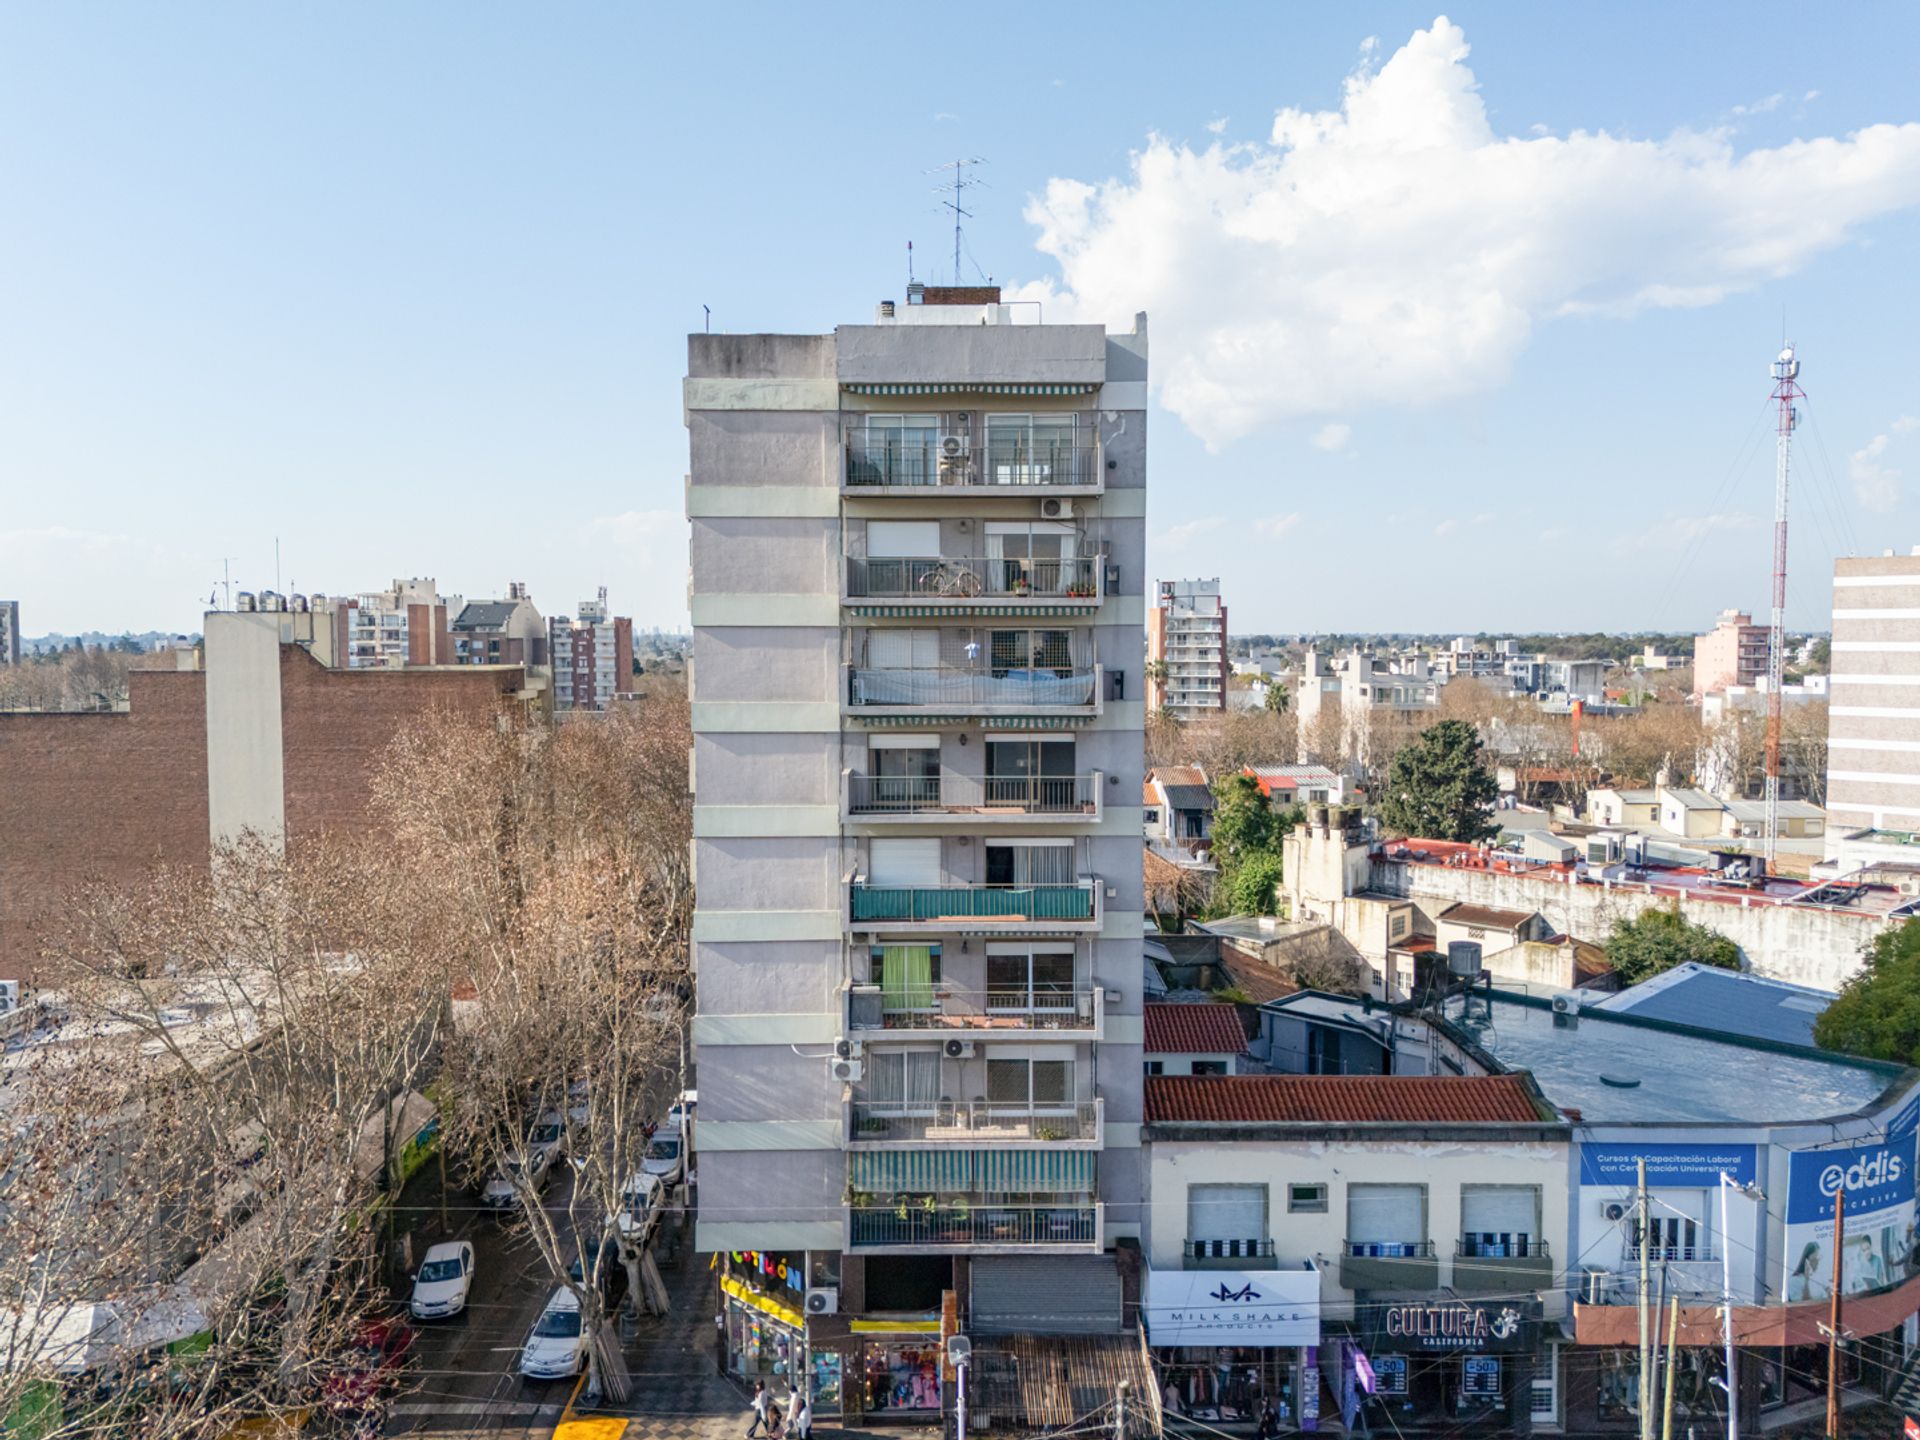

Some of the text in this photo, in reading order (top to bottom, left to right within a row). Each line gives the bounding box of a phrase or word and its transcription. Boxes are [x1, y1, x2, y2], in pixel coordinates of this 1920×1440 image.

[1644, 1155, 1705, 1164] Capacitación
[1707, 1155, 1741, 1163] Laboral
[1619, 1164, 1678, 1172] Cericación
[1232, 1313, 1300, 1321] SHAKE
[1386, 1307, 1489, 1337] CULTURA
